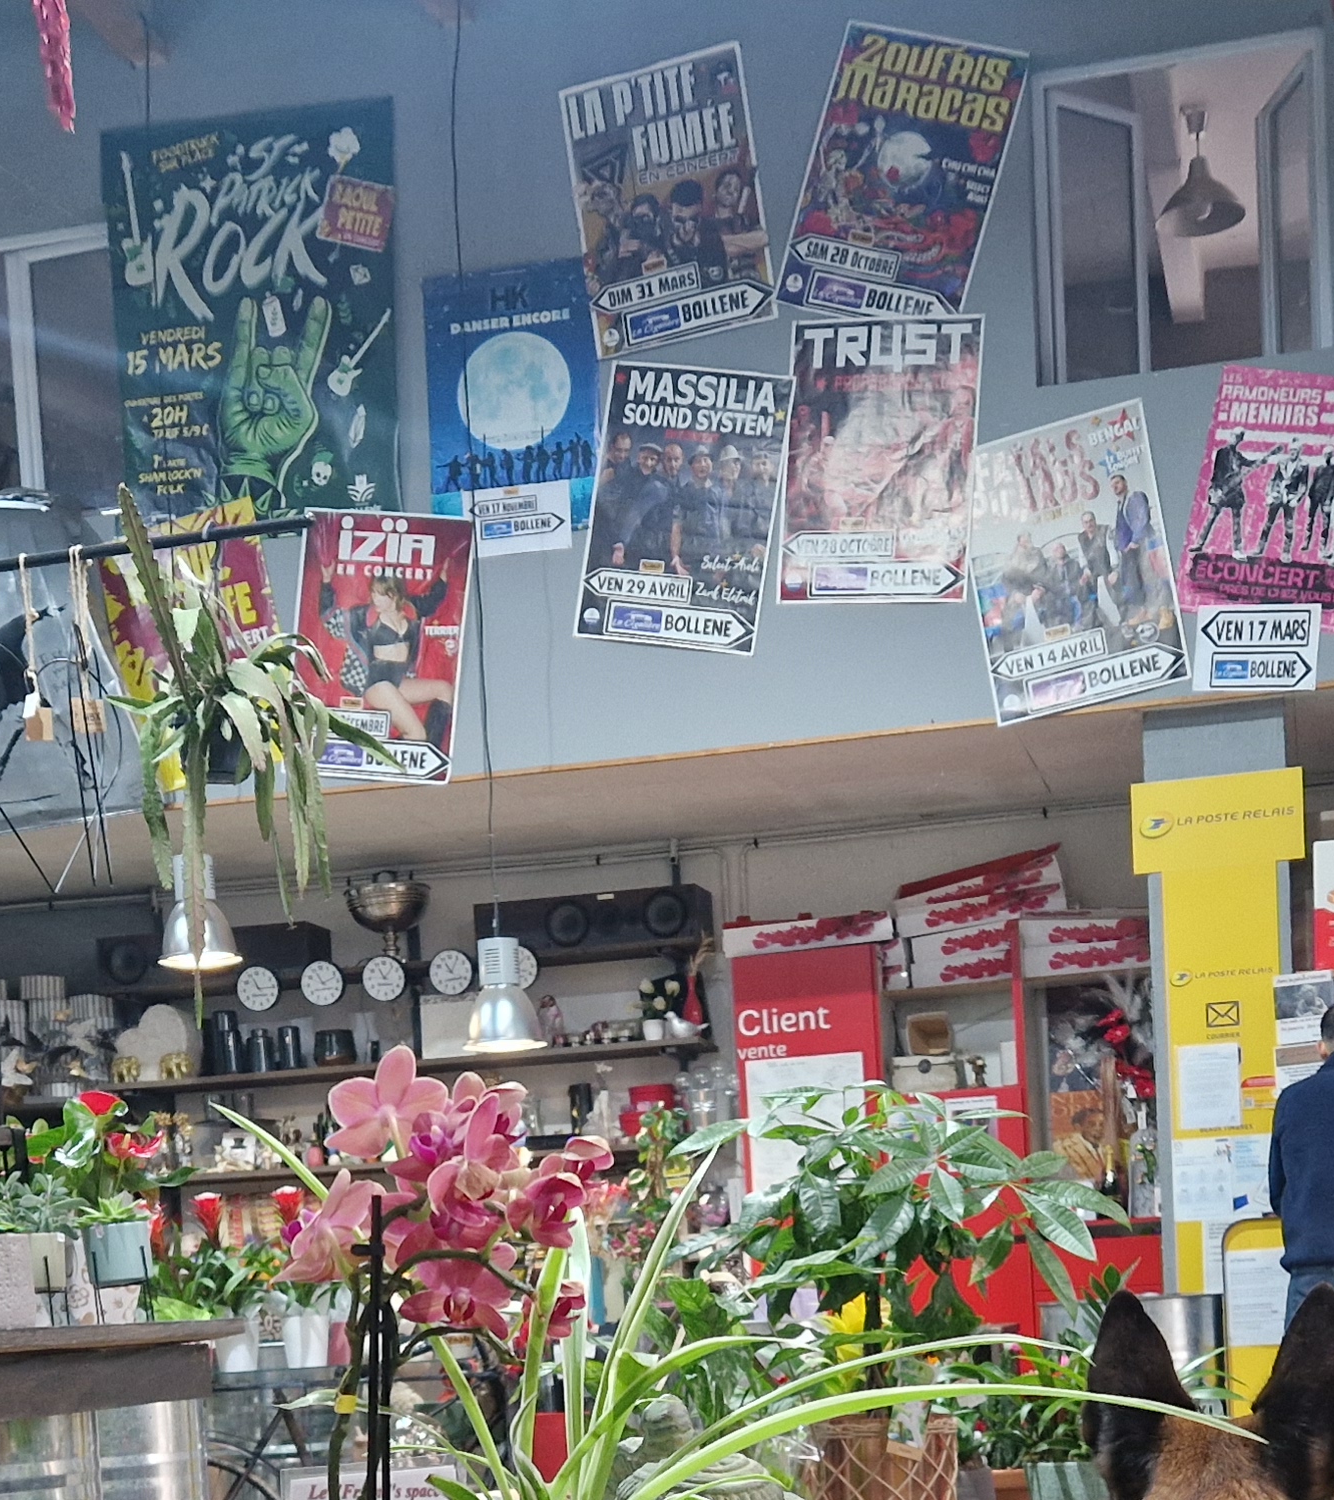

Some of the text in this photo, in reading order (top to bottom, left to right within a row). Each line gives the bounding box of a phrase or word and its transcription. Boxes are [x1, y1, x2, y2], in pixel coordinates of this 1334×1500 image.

[568, 89, 606, 140] LA
[154, 184, 327, 321] ROCK
[805, 241, 828, 261] SAM
[830, 246, 848, 264] 28
[607, 285, 634, 308] DIM
[637, 281, 655, 301] 31
[681, 289, 751, 323] BOLLENE
[512, 308, 571, 328] ENCORE
[140, 326, 205, 345] VENDREDI
[127, 342, 223, 375] 15 MARS
[803, 323, 974, 374] TRUST
[627, 369, 776, 413] MASSILIA
[1221, 384, 1323, 404] RAMONEURS
[151, 404, 188, 428] 20H
[622, 403, 693, 428] SOUND
[695, 409, 774, 437] SYSTEM
[1230, 402, 1319, 427] MENHIRS
[513, 516, 553, 533] BOLLENE
[337, 563, 433, 580] EN CONCERT
[869, 568, 942, 588] BOLLENE
[1208, 562, 1316, 589] CONCERT
[597, 576, 689, 600] VEN 29 AVRIL
[1251, 586, 1266, 599] DE
[1267, 587, 1297, 601] CHEZ
[664, 613, 733, 638] BOLLENE
[1216, 619, 1307, 642] VEN 17 MARS
[1005, 639, 1103, 676] VEN 14 AVRIL
[1249, 660, 1298, 679] BOLLENE
[1088, 653, 1163, 689] BOLLENE
[1176, 805, 1295, 827] LA POSTE RELAIS
[1207, 969, 1237, 979] POSTE
[1238, 966, 1274, 976] RELAIS
[738, 1006, 831, 1036] Client
[737, 1043, 788, 1061] vente
